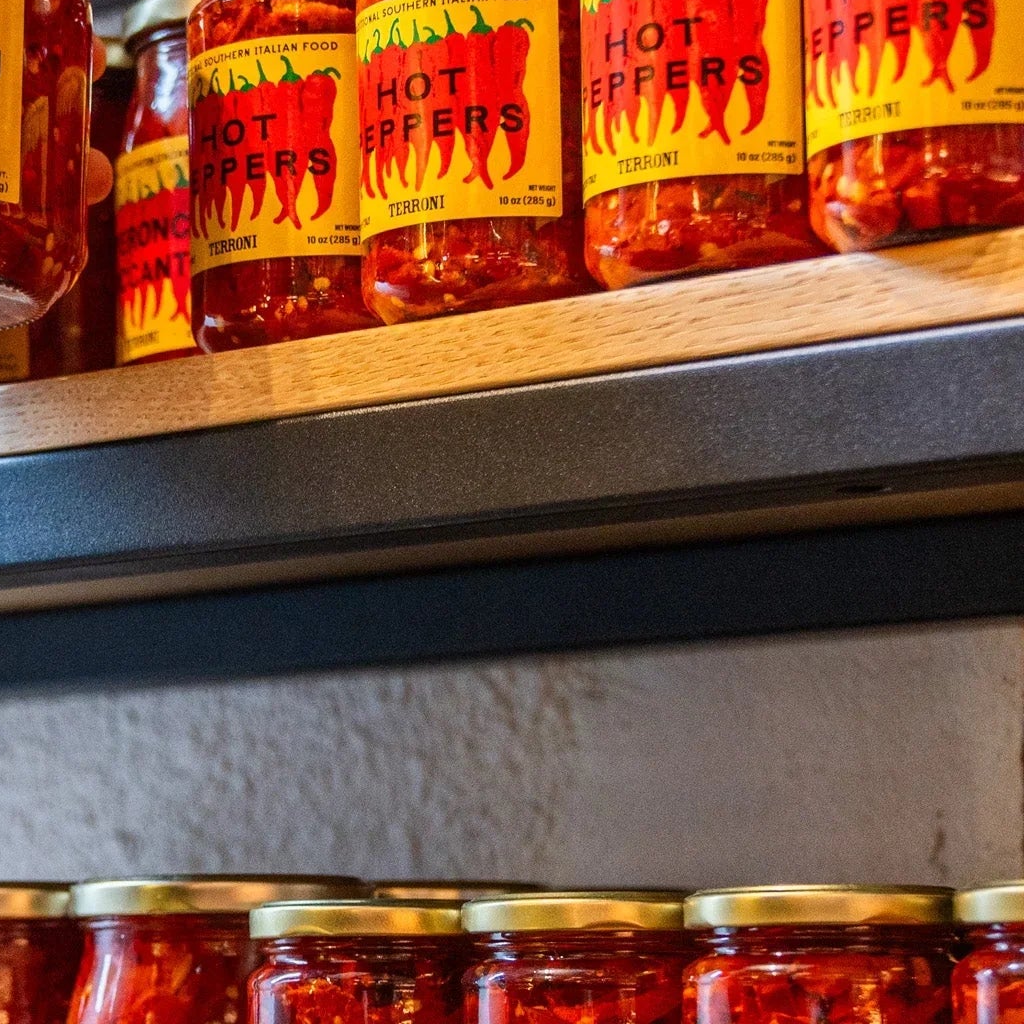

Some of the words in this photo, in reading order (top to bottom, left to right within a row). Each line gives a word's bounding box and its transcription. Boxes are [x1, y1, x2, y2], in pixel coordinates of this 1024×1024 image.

[604, 16, 703, 63] HOT
[205, 48, 250, 67] SOUTHERN
[254, 43, 298, 56] ITALIAN
[303, 41, 338, 52] FOOD
[376, 67, 467, 110] HOT
[363, 103, 524, 154] EPPERS
[839, 101, 901, 129] TERRONI
[201, 114, 276, 151] HOT
[192, 148, 331, 195] EPPERS
[617, 151, 679, 175] TERRONI
[389, 195, 445, 218] TERRONI
[499, 196, 508, 206] 10
[511, 197, 521, 205] oz
[523, 196, 544, 206] (285
[546, 196, 556, 207] g)
[209, 235, 258, 256] TERRONI
[307, 236, 316, 244] 10
[330, 235, 350, 245] (285
